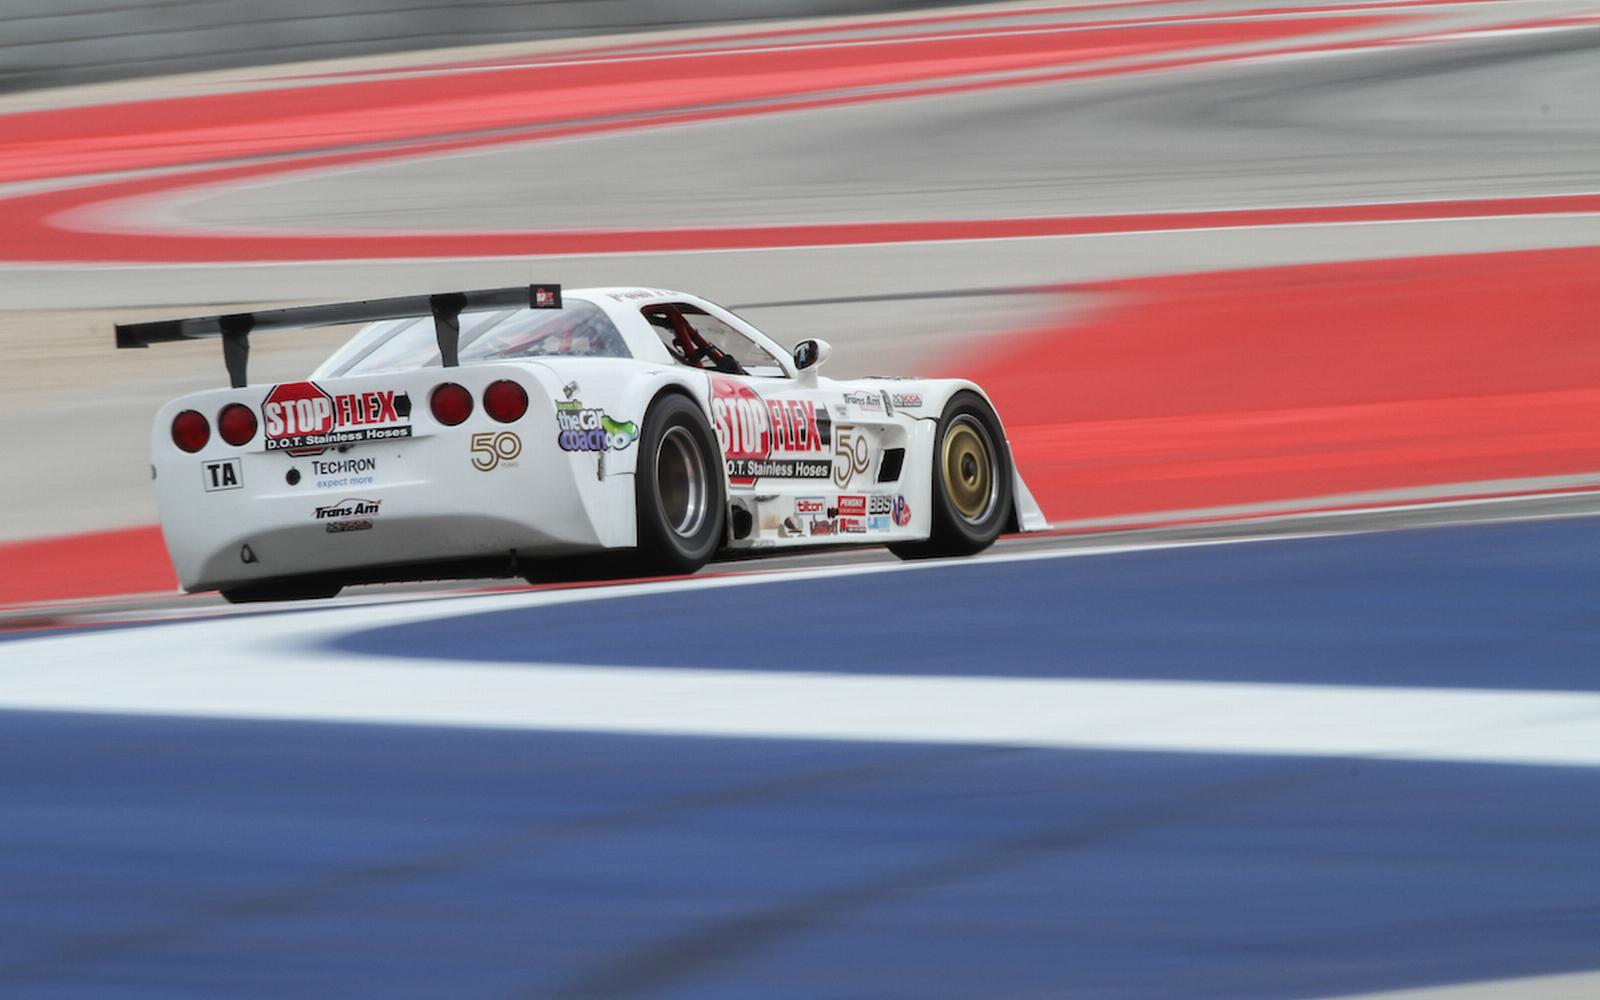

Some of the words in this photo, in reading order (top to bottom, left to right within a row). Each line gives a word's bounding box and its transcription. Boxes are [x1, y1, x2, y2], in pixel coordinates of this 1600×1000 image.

[843, 393, 865, 406] Trans
[866, 395, 880, 406] Am
[266, 397, 330, 437] STOP
[335, 390, 397, 427] FLEX
[712, 397, 768, 453] STOP
[766, 400, 821, 452] FLEX
[267, 437, 303, 450] D.O.T.
[306, 431, 363, 446] Stainless
[366, 427, 408, 440] Hoses
[471, 431, 522, 472] 50
[834, 425, 870, 489] 50
[207, 462, 237, 487] TA
[312, 458, 376, 475] TECHRON
[747, 461, 793, 476] Stainless
[795, 462, 828, 477] Hoses
[316, 477, 347, 489] expect
[349, 476, 373, 485] more
[315, 506, 352, 519] Trans
[354, 503, 379, 514] Am
[869, 496, 892, 513] BBS
